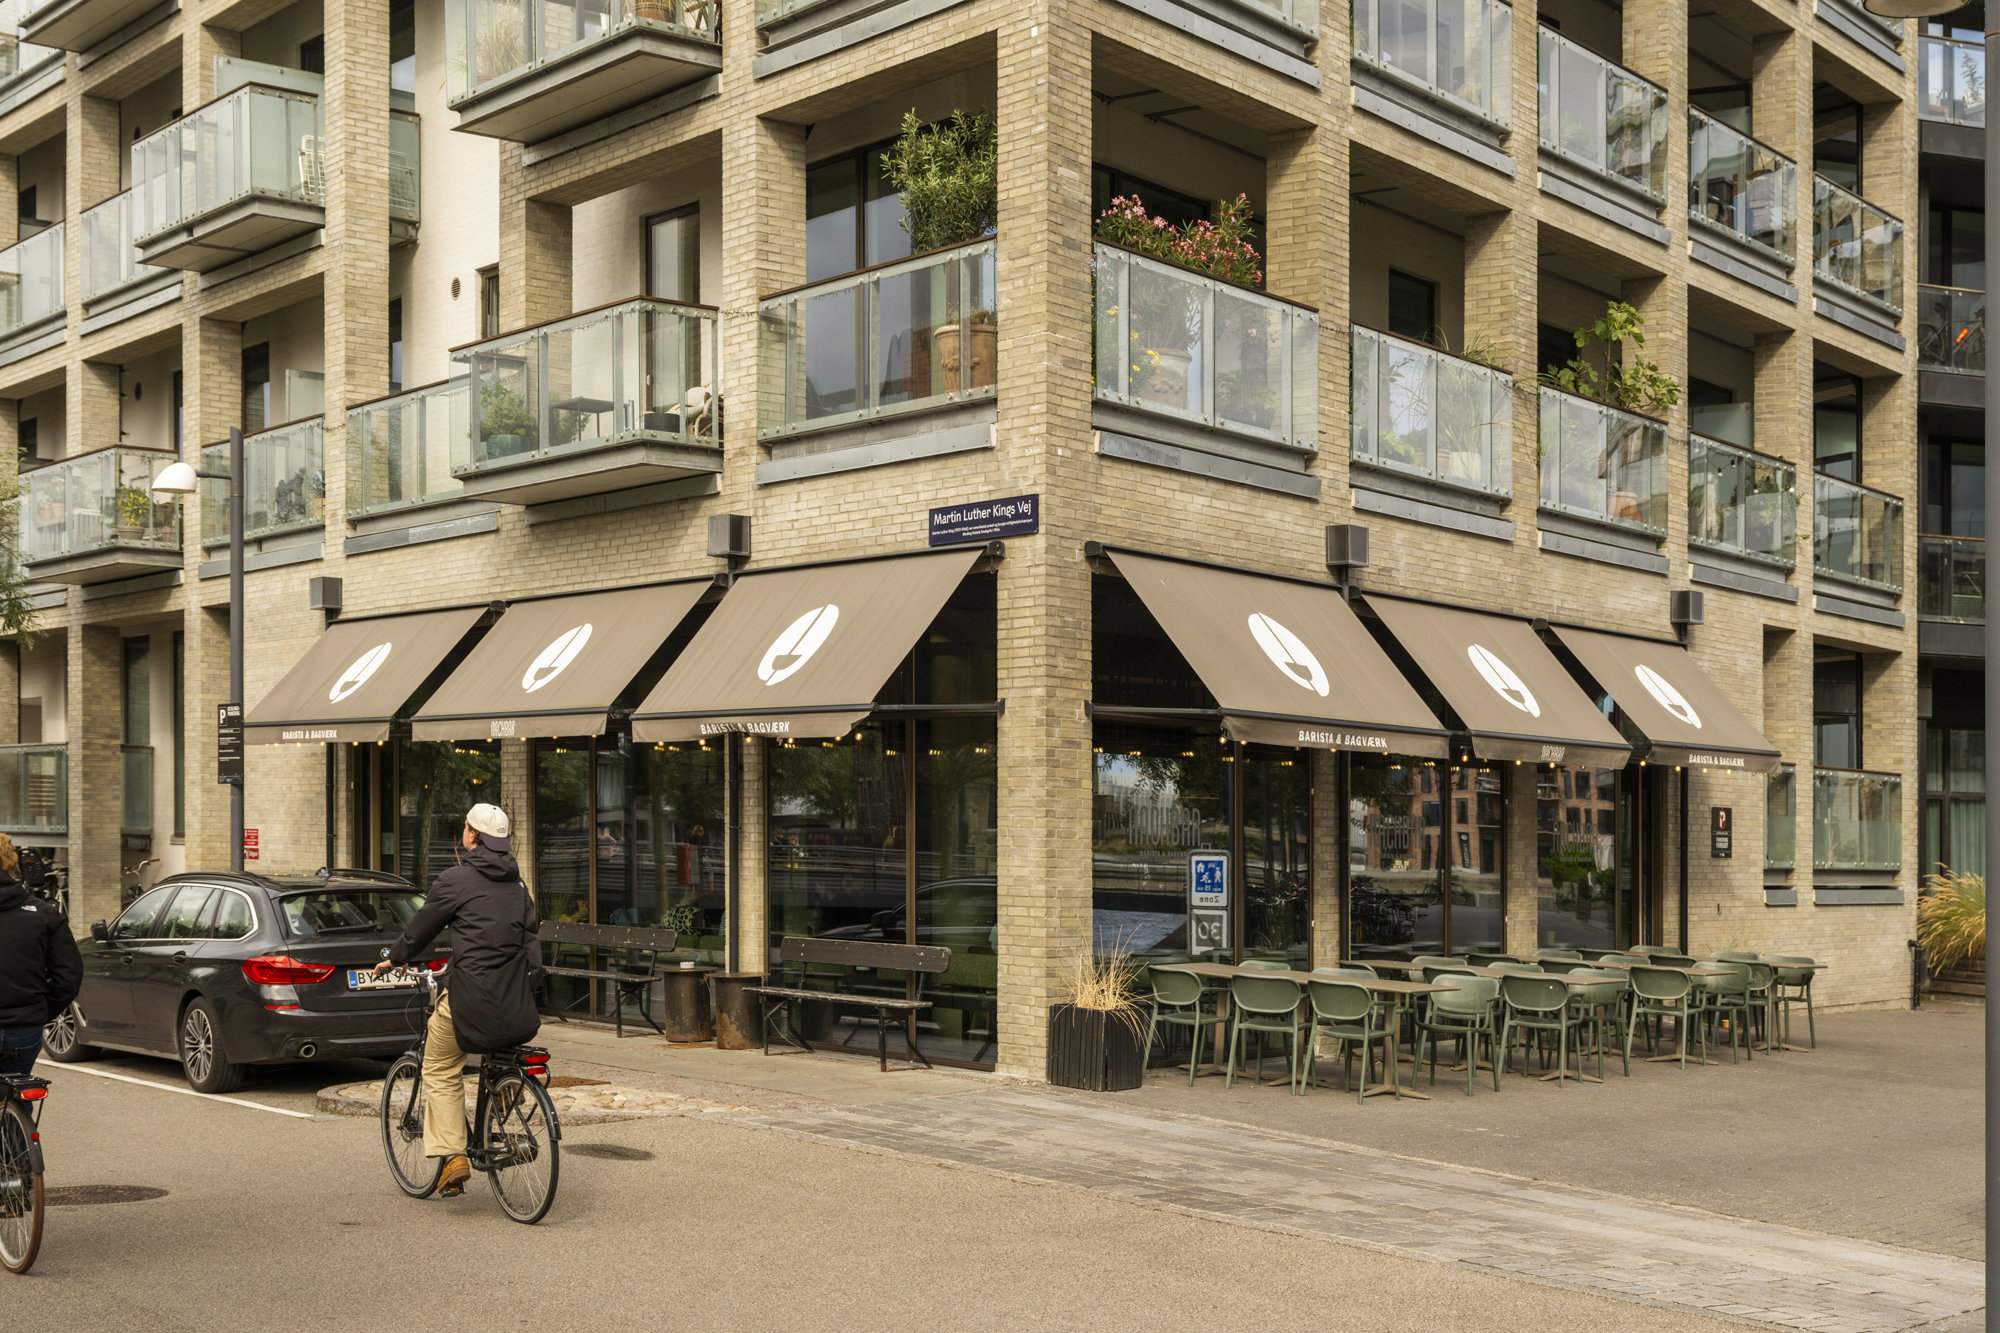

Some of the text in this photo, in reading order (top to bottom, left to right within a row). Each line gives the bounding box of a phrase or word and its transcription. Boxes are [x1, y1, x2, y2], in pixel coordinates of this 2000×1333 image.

[933, 501, 1031, 525] Martin Luther Kings Vej
[220, 709, 226, 724] P
[700, 721, 790, 734] BARISTA & BAGVÆRK
[282, 731, 304, 740] BARISTA
[1299, 731, 1387, 747] BARISTA & BAGVÆRK
[1689, 754, 1714, 764] BARISTA
[357, 972, 375, 984] BY
